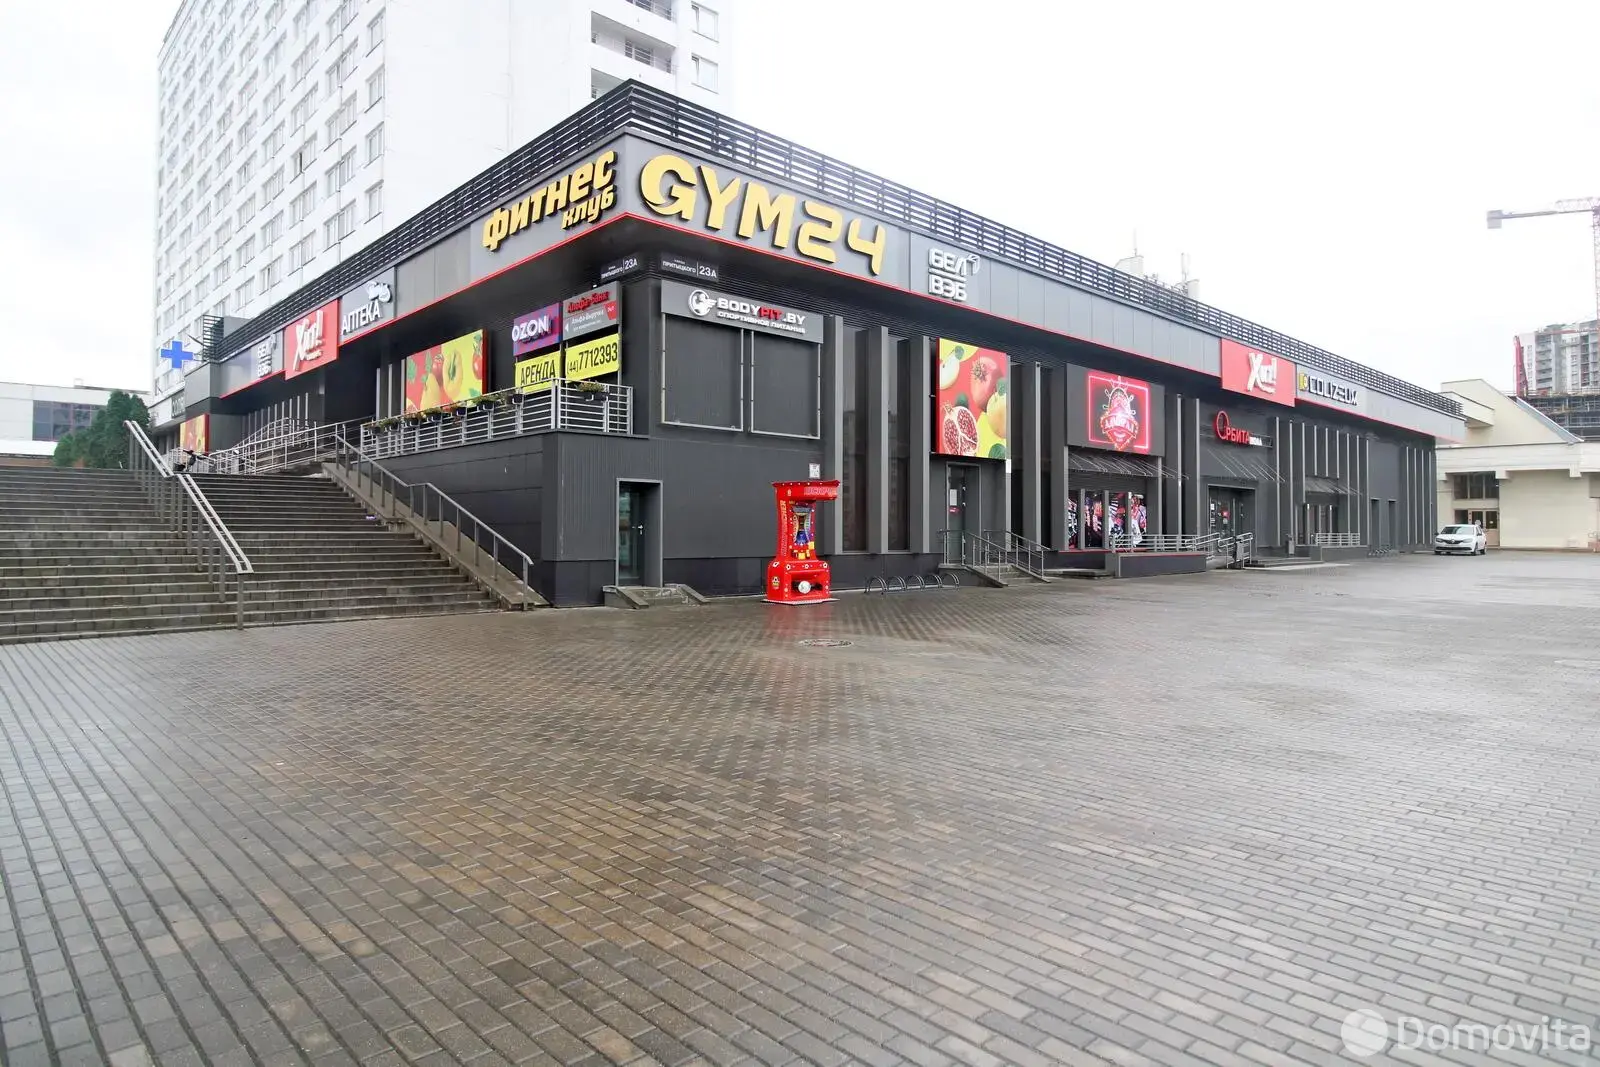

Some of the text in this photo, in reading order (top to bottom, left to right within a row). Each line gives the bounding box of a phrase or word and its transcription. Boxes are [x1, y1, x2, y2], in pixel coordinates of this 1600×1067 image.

[640, 154, 886, 275] GYM24
[929, 275, 967, 301] ВЭБ
[340, 299, 382, 337] АПТЕКА
[511, 315, 550, 341] OZON
[717, 310, 806, 334] СПОРТИВНОЕ ПИТАНИЕ
[520, 359, 556, 386] АРЕНДА
